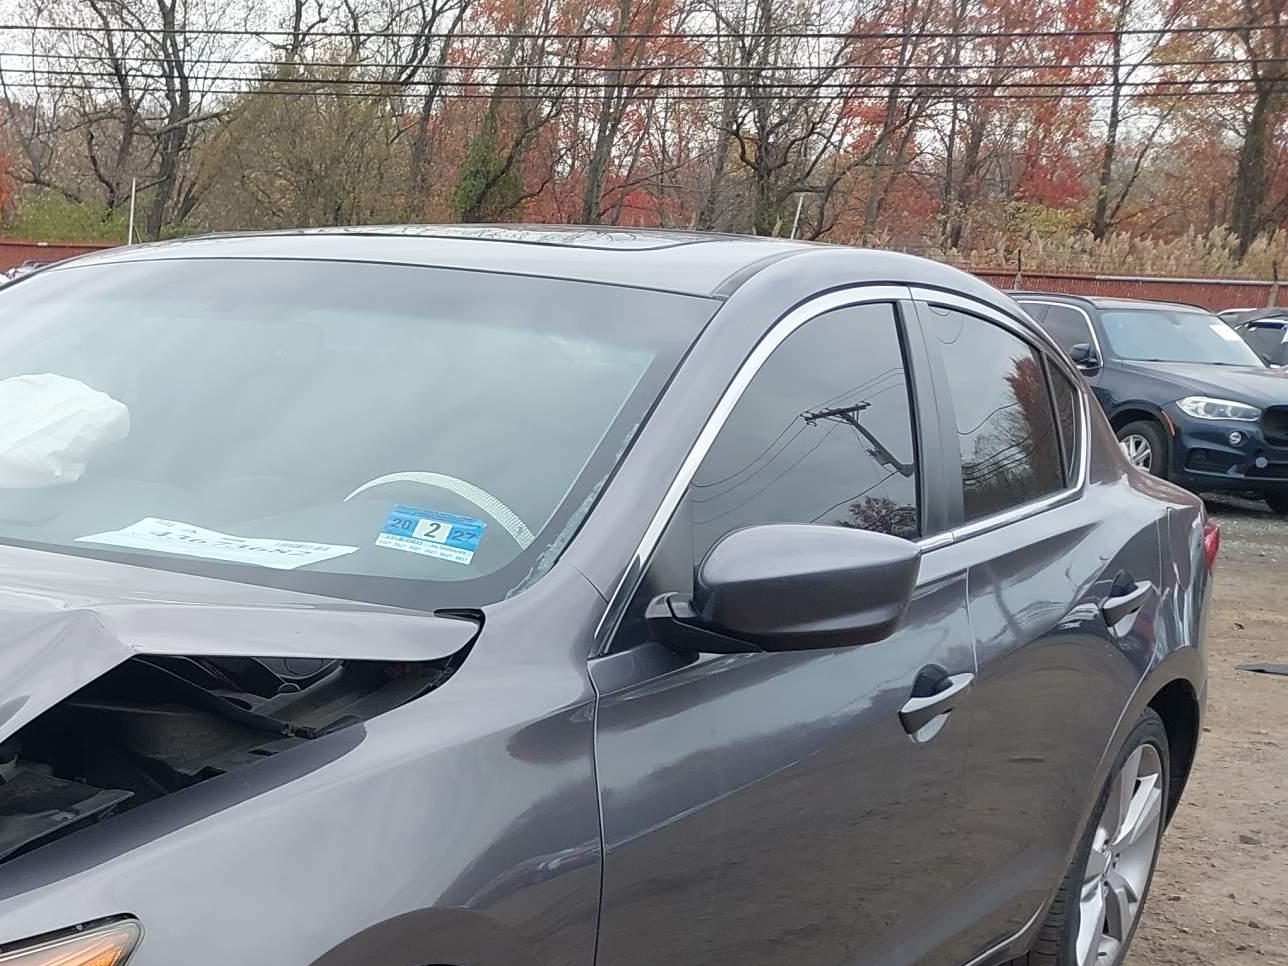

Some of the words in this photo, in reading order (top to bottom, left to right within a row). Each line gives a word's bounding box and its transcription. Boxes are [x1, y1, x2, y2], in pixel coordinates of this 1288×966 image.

[391, 517, 412, 530] 20
[423, 522, 442, 538] 2
[451, 530, 477, 543] 27
